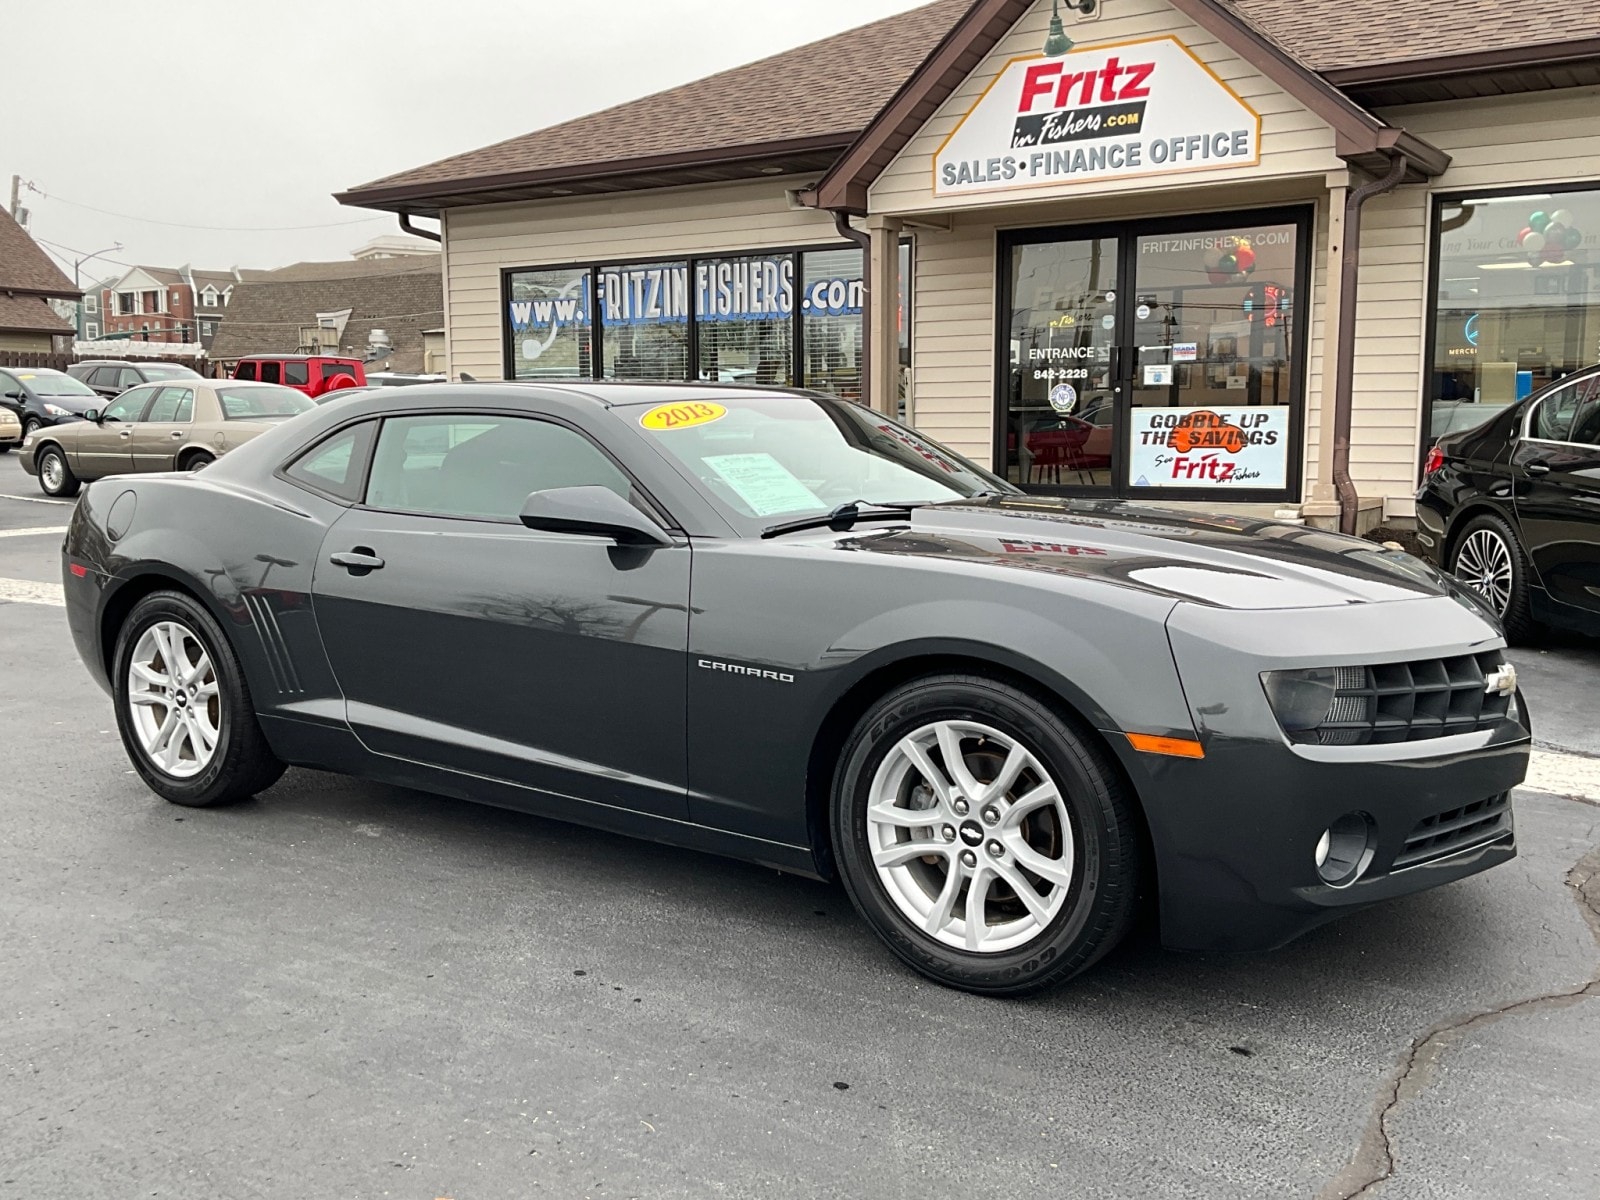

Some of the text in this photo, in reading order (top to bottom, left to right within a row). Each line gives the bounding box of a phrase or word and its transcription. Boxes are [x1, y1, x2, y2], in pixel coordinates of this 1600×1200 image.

[1018, 57, 1156, 113] Fritz
[1012, 111, 1139, 148] in Fishers .COM
[942, 130, 1249, 186] SALES FINANCE OFFICE
[696, 259, 794, 316] FISHERS
[1029, 346, 1095, 359] ENTRANCE
[1033, 369, 1088, 379] 842-2228
[656, 403, 715, 428] 2013
[1150, 413, 1269, 428] GOBBLE UP
[1141, 430, 1279, 445] THE SAVINGS
[1171, 453, 1236, 480] Fritz
[698, 659, 795, 683] CAMARO
